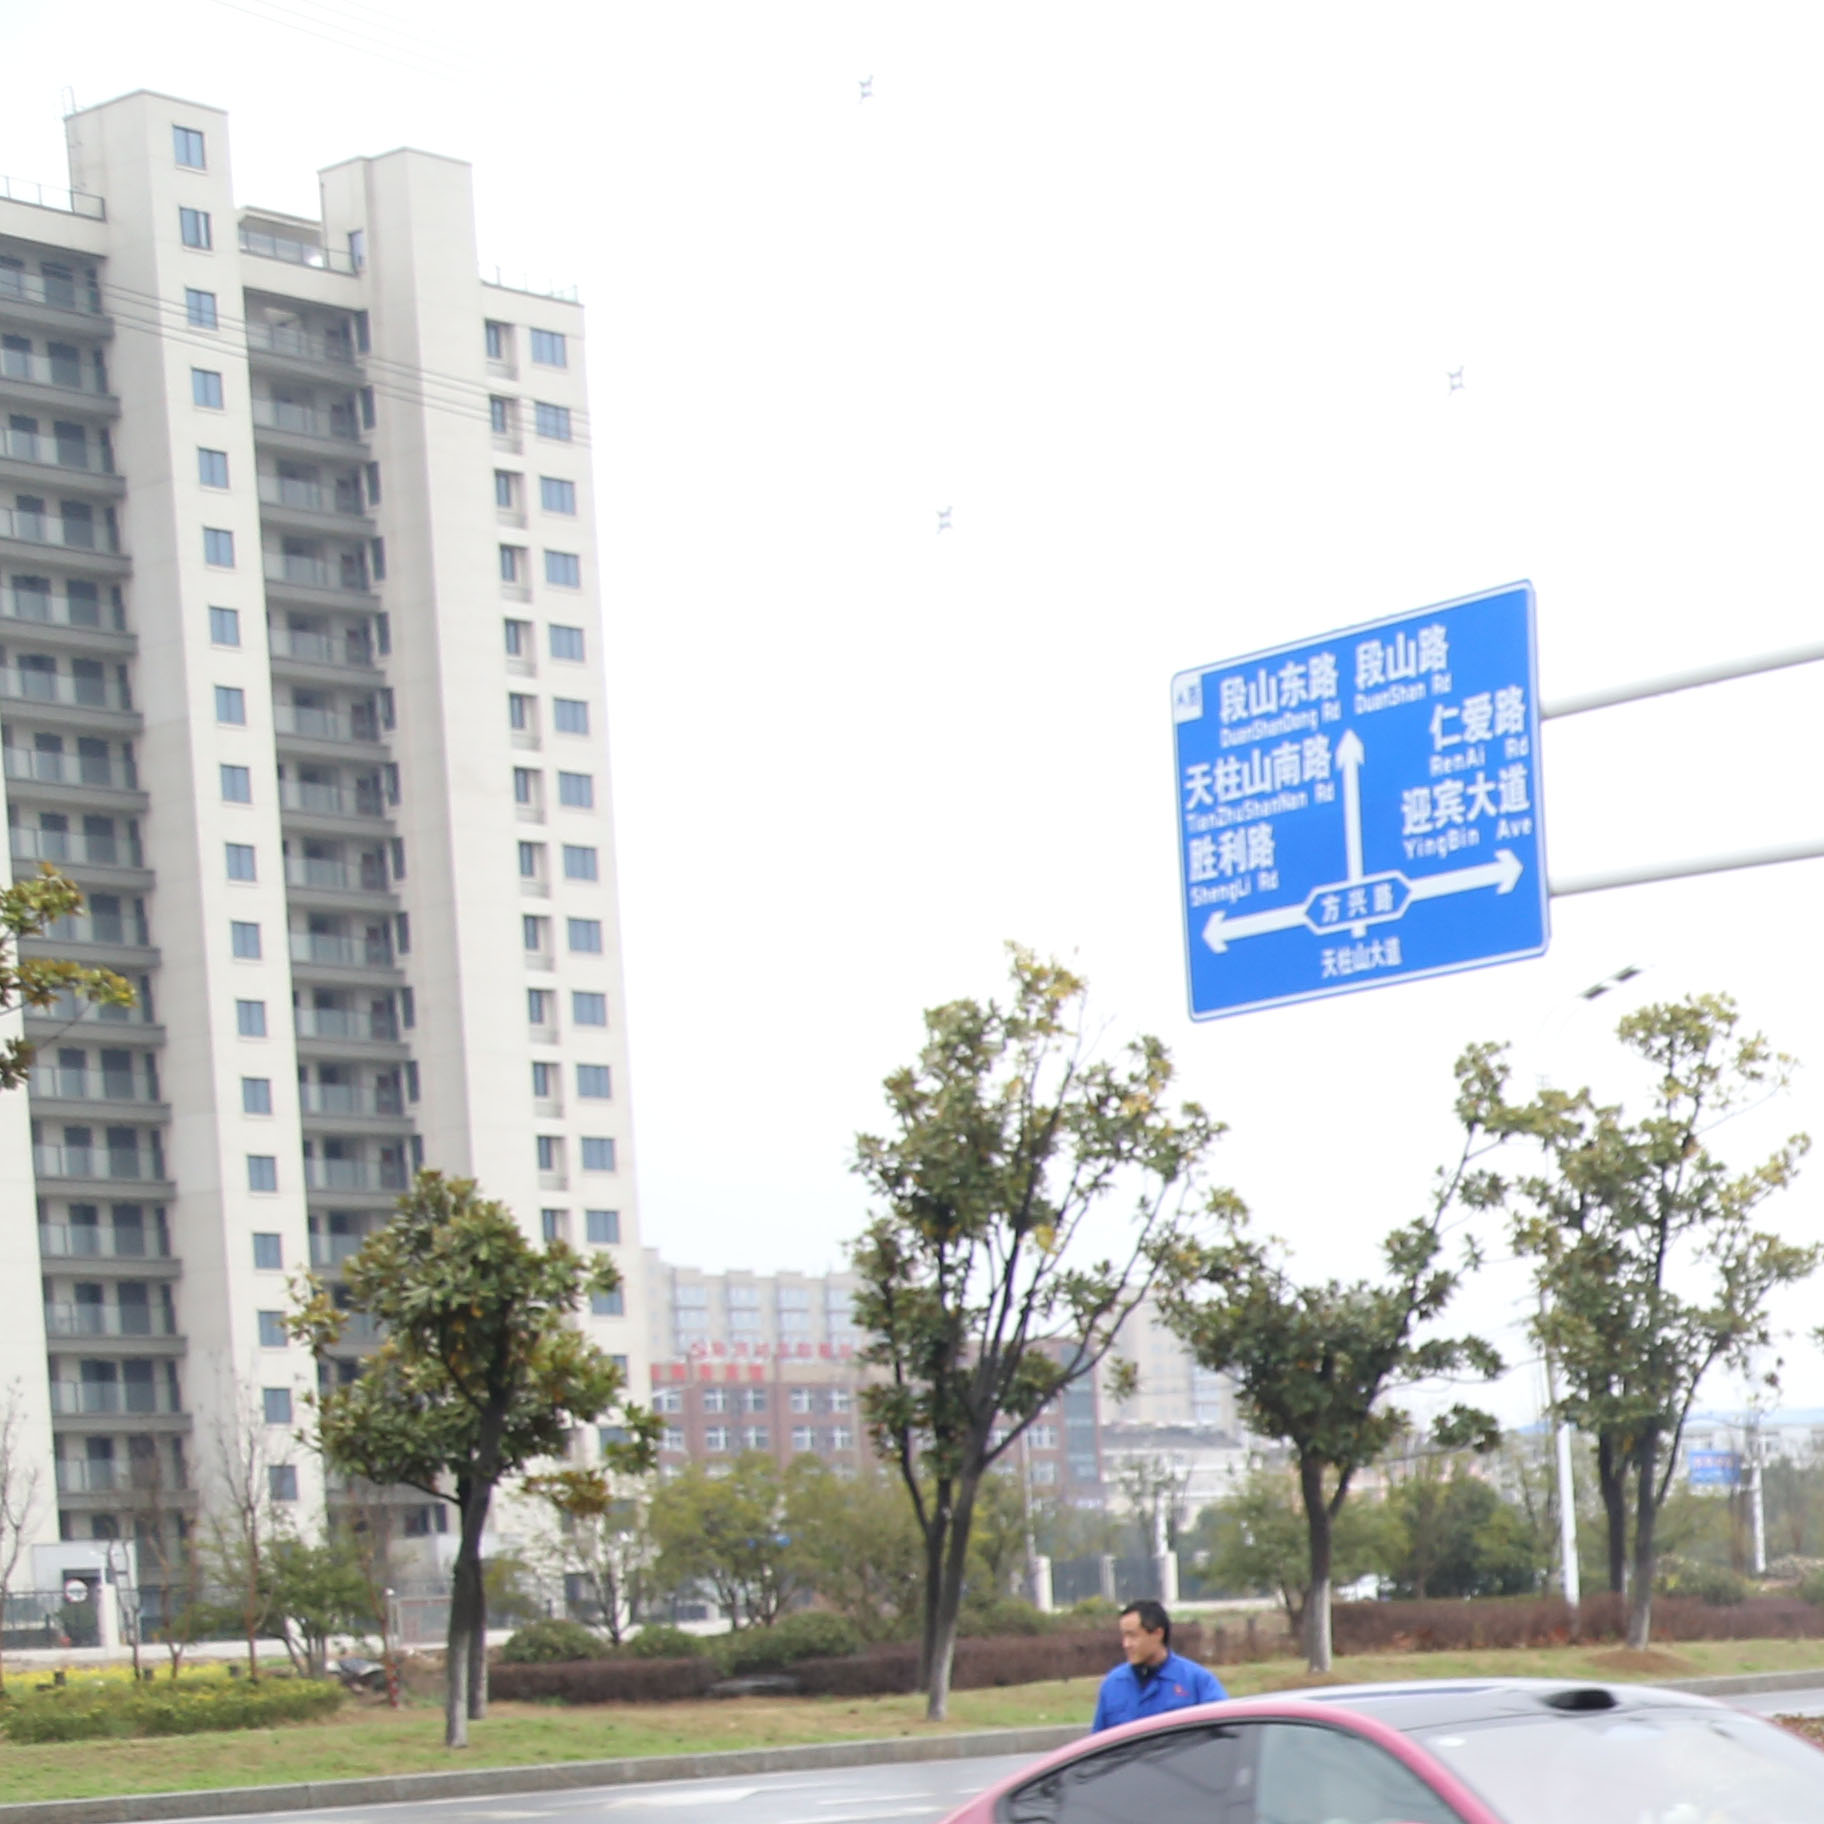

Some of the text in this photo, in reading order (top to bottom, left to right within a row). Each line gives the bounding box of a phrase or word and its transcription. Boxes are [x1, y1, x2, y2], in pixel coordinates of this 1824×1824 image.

[1354, 623, 1449, 690] 段山路
[1219, 652, 1339, 724] 段山东路
[1354, 672, 1452, 715] DuanShan Rd
[1321, 700, 1342, 723] Rd
[1429, 684, 1526, 752] 仁爱路
[1184, 733, 1333, 811] 天柱山南路
[1429, 735, 1530, 777] RenAi Rd
[1313, 781, 1336, 804] Rd
[1401, 763, 1531, 835] 迎宾大道
[1188, 822, 1276, 883] 胜利路
[1402, 817, 1533, 860] YingBin Ave
[1190, 869, 1280, 908] ShengLi Rd
[1321, 936, 1403, 979] 天柱山大道
